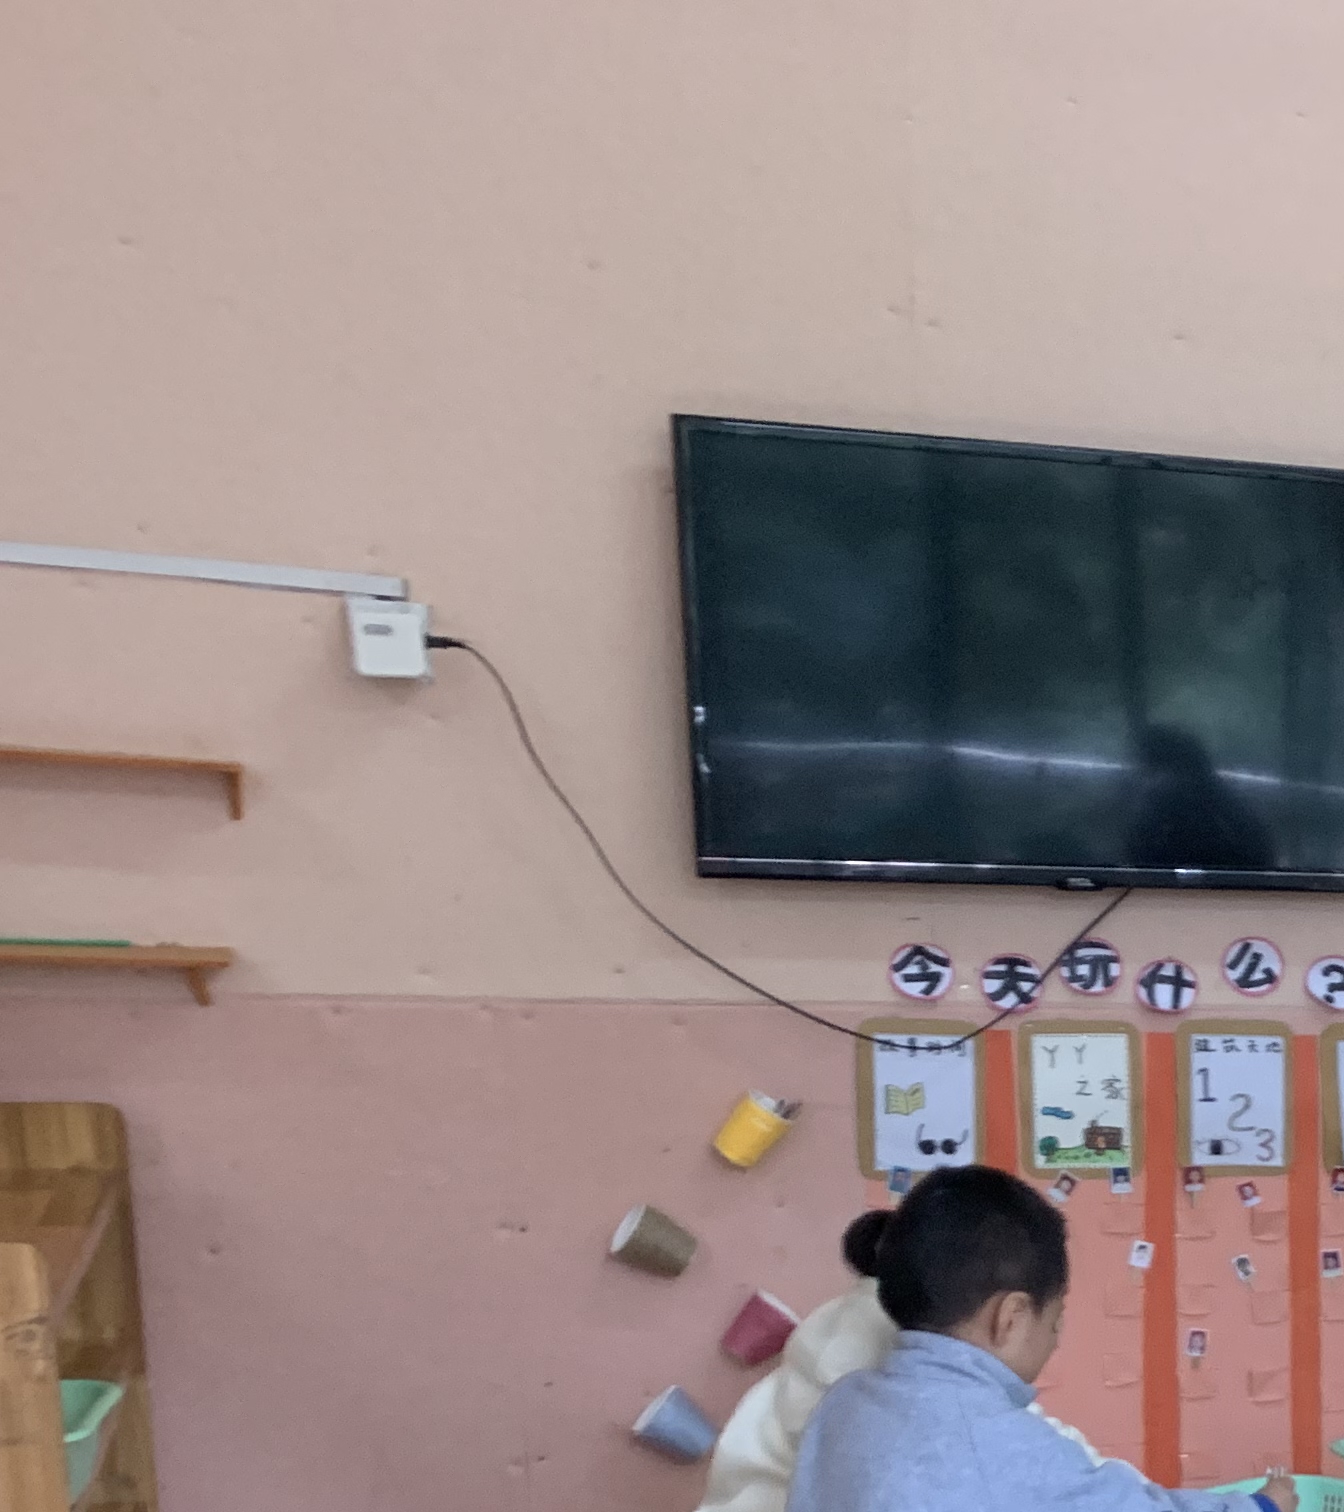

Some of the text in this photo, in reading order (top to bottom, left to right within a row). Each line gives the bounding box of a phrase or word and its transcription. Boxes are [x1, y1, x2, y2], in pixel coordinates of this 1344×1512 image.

[1196, 1067, 1218, 1103] 1
[1227, 1093, 1256, 1132] 2
[1255, 1128, 1277, 1163] 3
